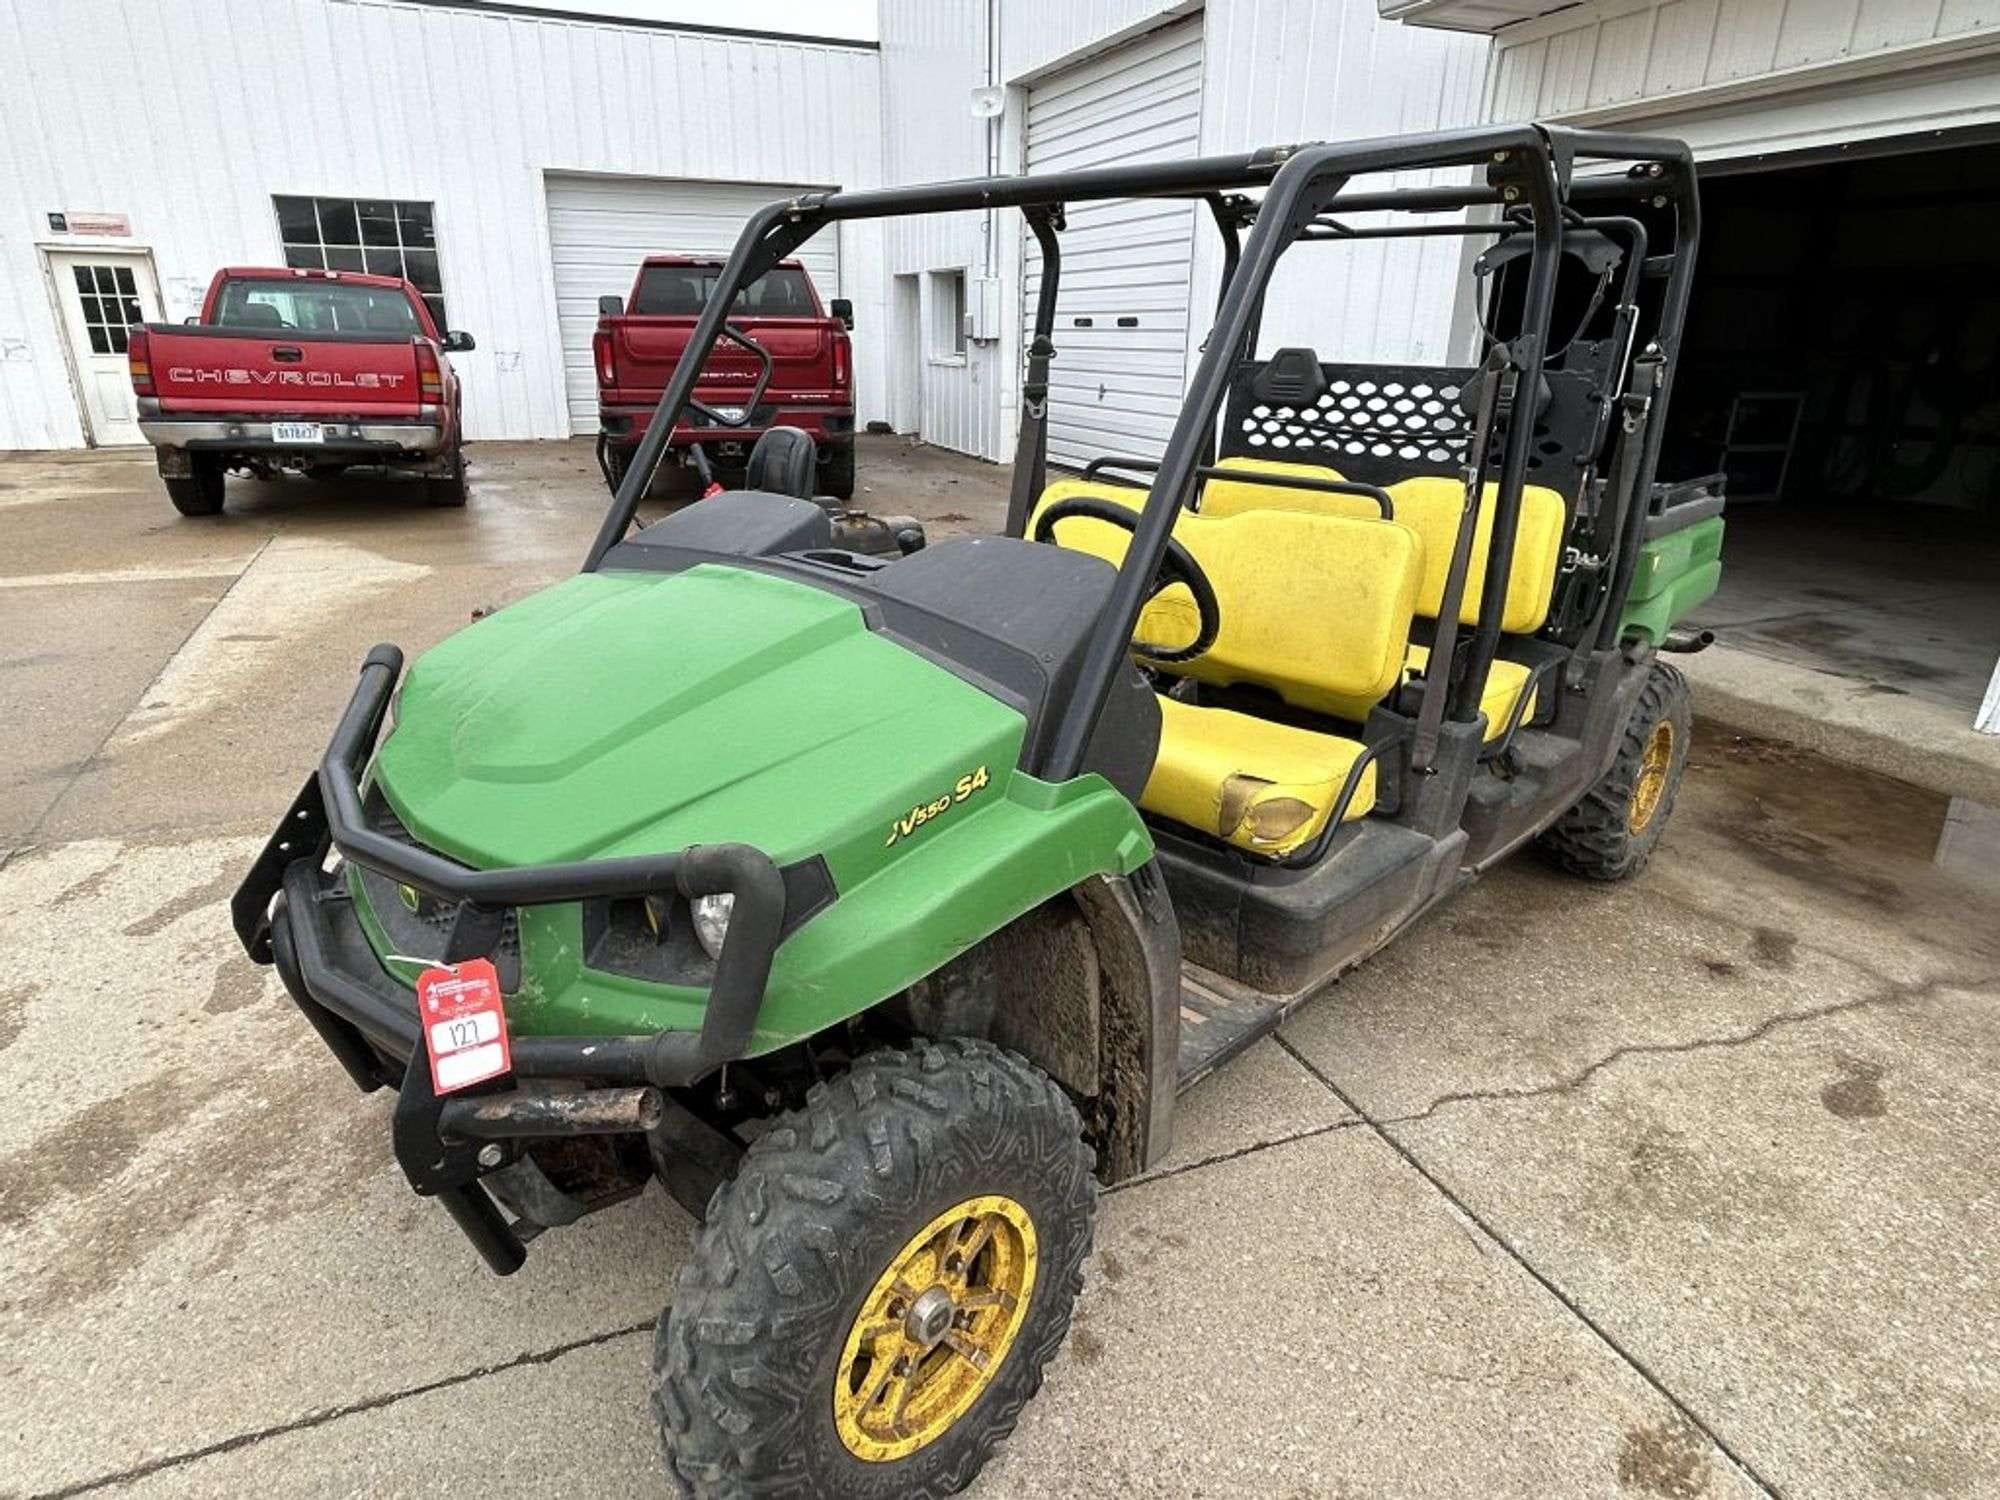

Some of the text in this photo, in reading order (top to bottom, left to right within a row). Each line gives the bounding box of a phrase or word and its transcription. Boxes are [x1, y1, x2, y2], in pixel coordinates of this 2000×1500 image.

[169, 367, 404, 388] CHEVROLET
[954, 764, 991, 803] S4
[448, 1018, 480, 1047] 127
